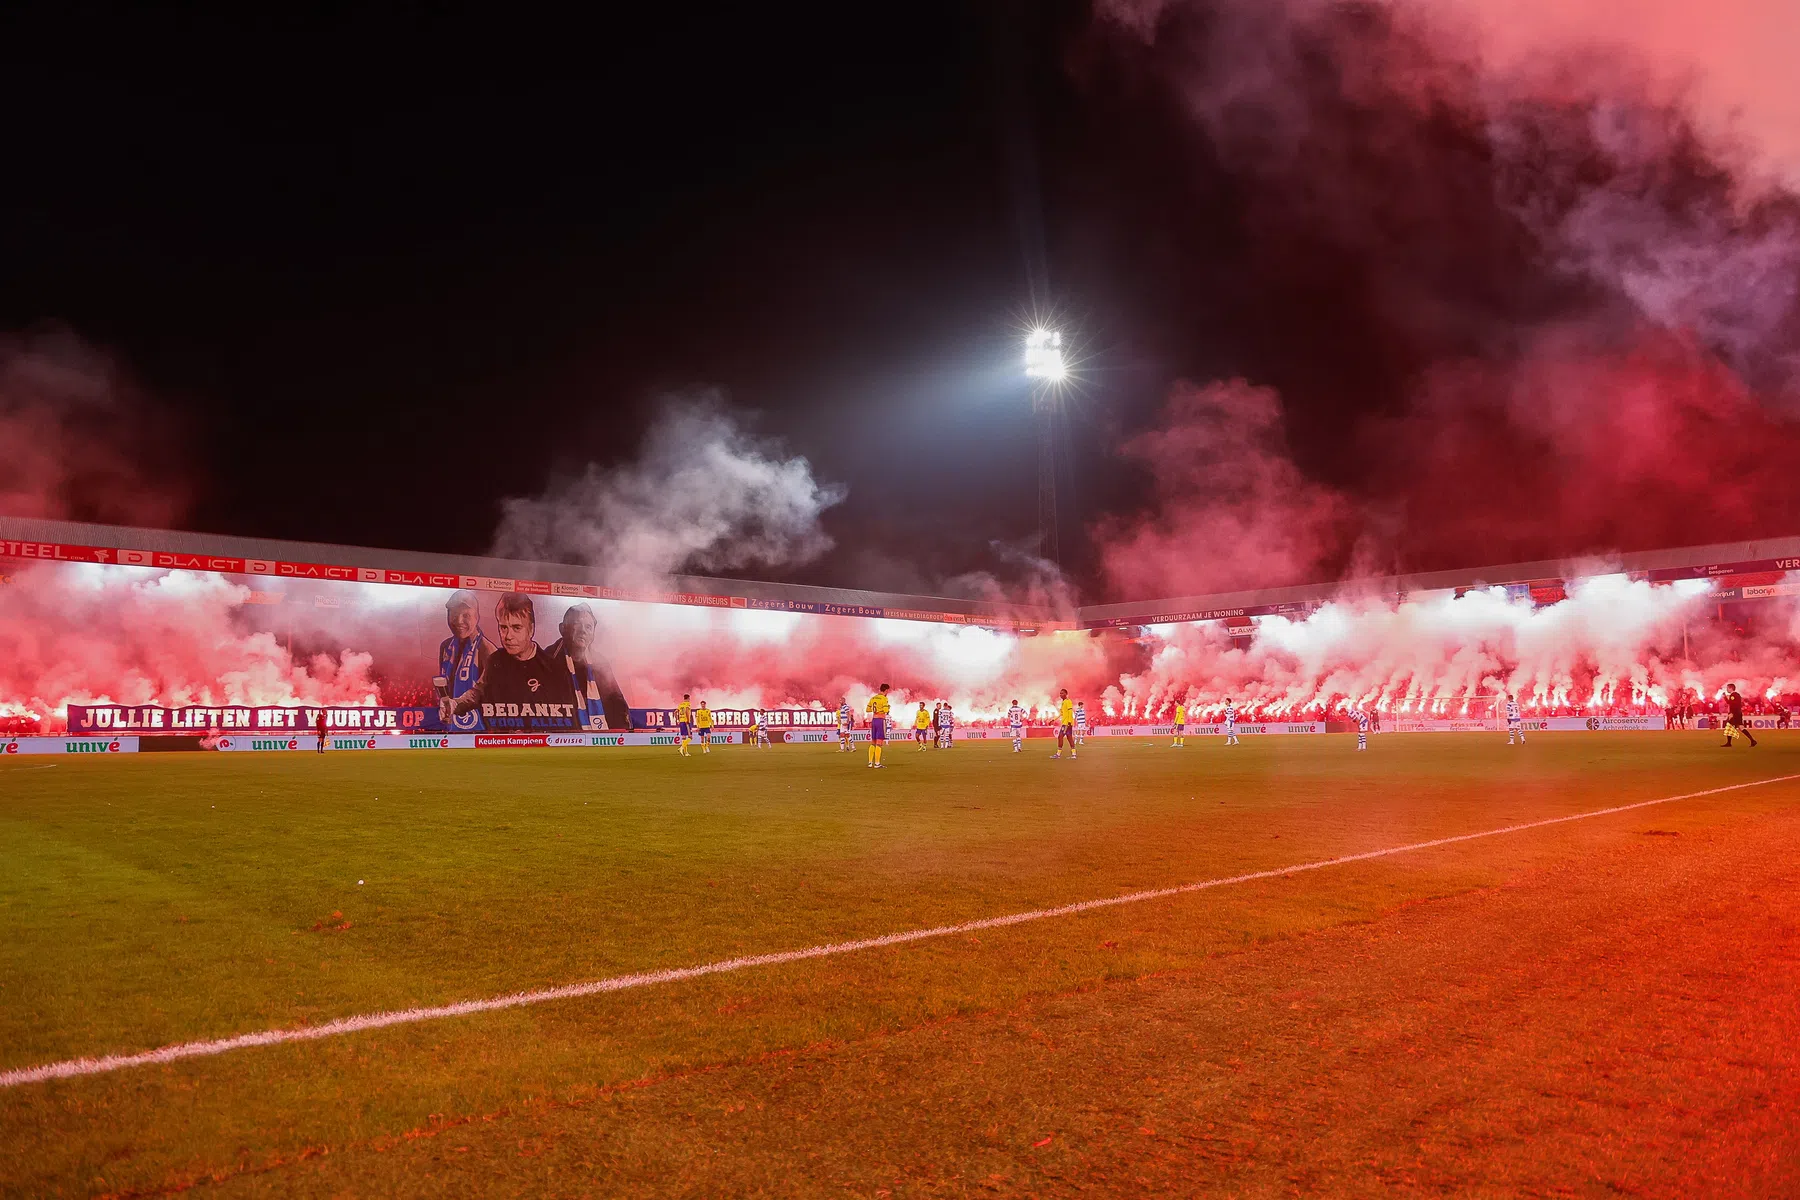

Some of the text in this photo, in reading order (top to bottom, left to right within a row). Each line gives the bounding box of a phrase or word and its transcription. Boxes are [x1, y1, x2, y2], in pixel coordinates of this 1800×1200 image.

[159, 554, 239, 570] DLA ICT
[281, 565, 352, 577] DLA ICT
[429, 576, 454, 586] ICT
[694, 596, 728, 605] ADVISEURS
[752, 598, 814, 610] Zegers Bouw
[825, 603, 882, 616] Zegers Bouw
[1152, 609, 1244, 623] VERDUURZAAM JE WONING
[481, 703, 574, 717] BEDANKT
[80, 708, 164, 728] JULLIE
[172, 708, 251, 728] LIETEN
[258, 709, 299, 727] HET
[402, 710, 424, 727] OP
[488, 718, 572, 727] VOOR ALLES
[646, 711, 665, 726] DE
[1014, 713, 1018, 721] 8
[1195, 724, 1219, 734] univé
[1240, 724, 1266, 734] univé
[1288, 723, 1315, 733] univé
[1520, 719, 1548, 731] nivé
[1754, 719, 1775, 729] ON
[803, 730, 828, 742] univé
[890, 730, 912, 740] univé
[966, 729, 986, 739] univé
[1111, 727, 1133, 736] univé
[252, 735, 297, 750] univé
[334, 735, 377, 749] univé
[409, 735, 449, 748] univé
[478, 736, 543, 747] Keuken Kampioen
[555, 736, 583, 744] divisie
[592, 734, 624, 746] univé
[650, 732, 681, 745] univé
[66, 737, 120, 753] univé
